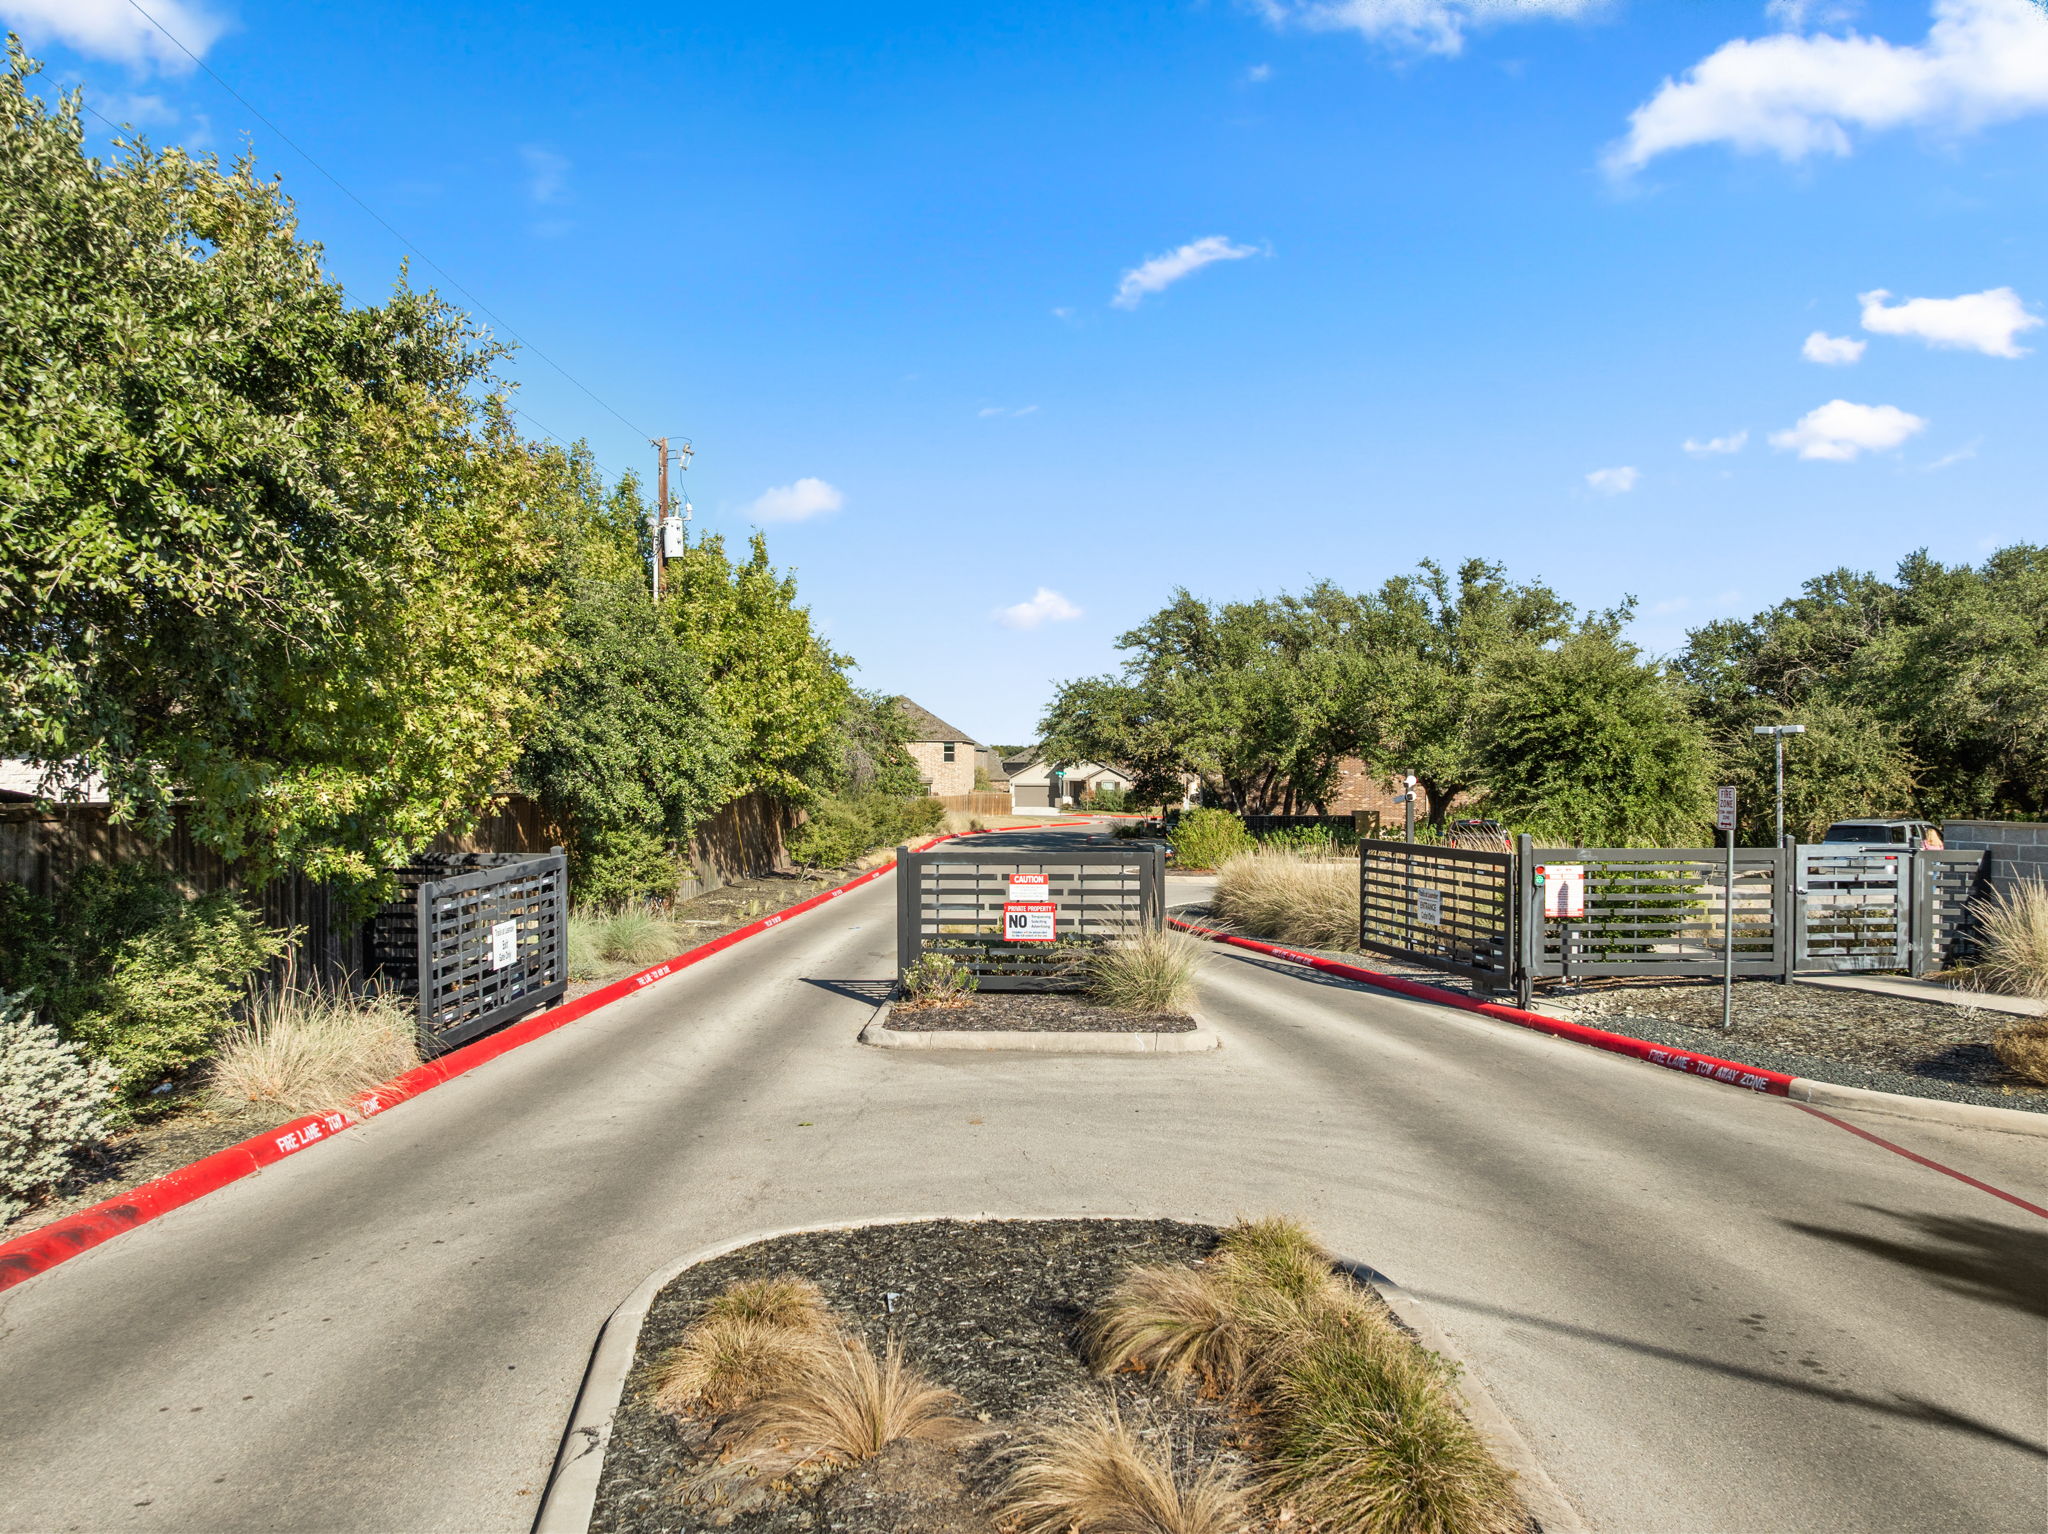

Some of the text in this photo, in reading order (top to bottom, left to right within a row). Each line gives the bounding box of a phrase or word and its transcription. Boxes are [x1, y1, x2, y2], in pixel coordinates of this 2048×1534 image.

[1720, 790, 1732, 798] FIRE
[1720, 800, 1733, 808] ZONE
[1420, 901, 1437, 911] ENTRANCE
[1009, 914, 1027, 928] NO
[1648, 1049, 1668, 1063] FIRE
[1666, 1054, 1690, 1069] LANE
[1696, 1060, 1715, 1075] TOW
[1715, 1066, 1740, 1081] AWAY
[1740, 1072, 1768, 1090] ZONE
[276, 1132, 299, 1152] FIRE
[296, 1122, 322, 1144] LANE
[363, 1096, 382, 1116] ZONE
